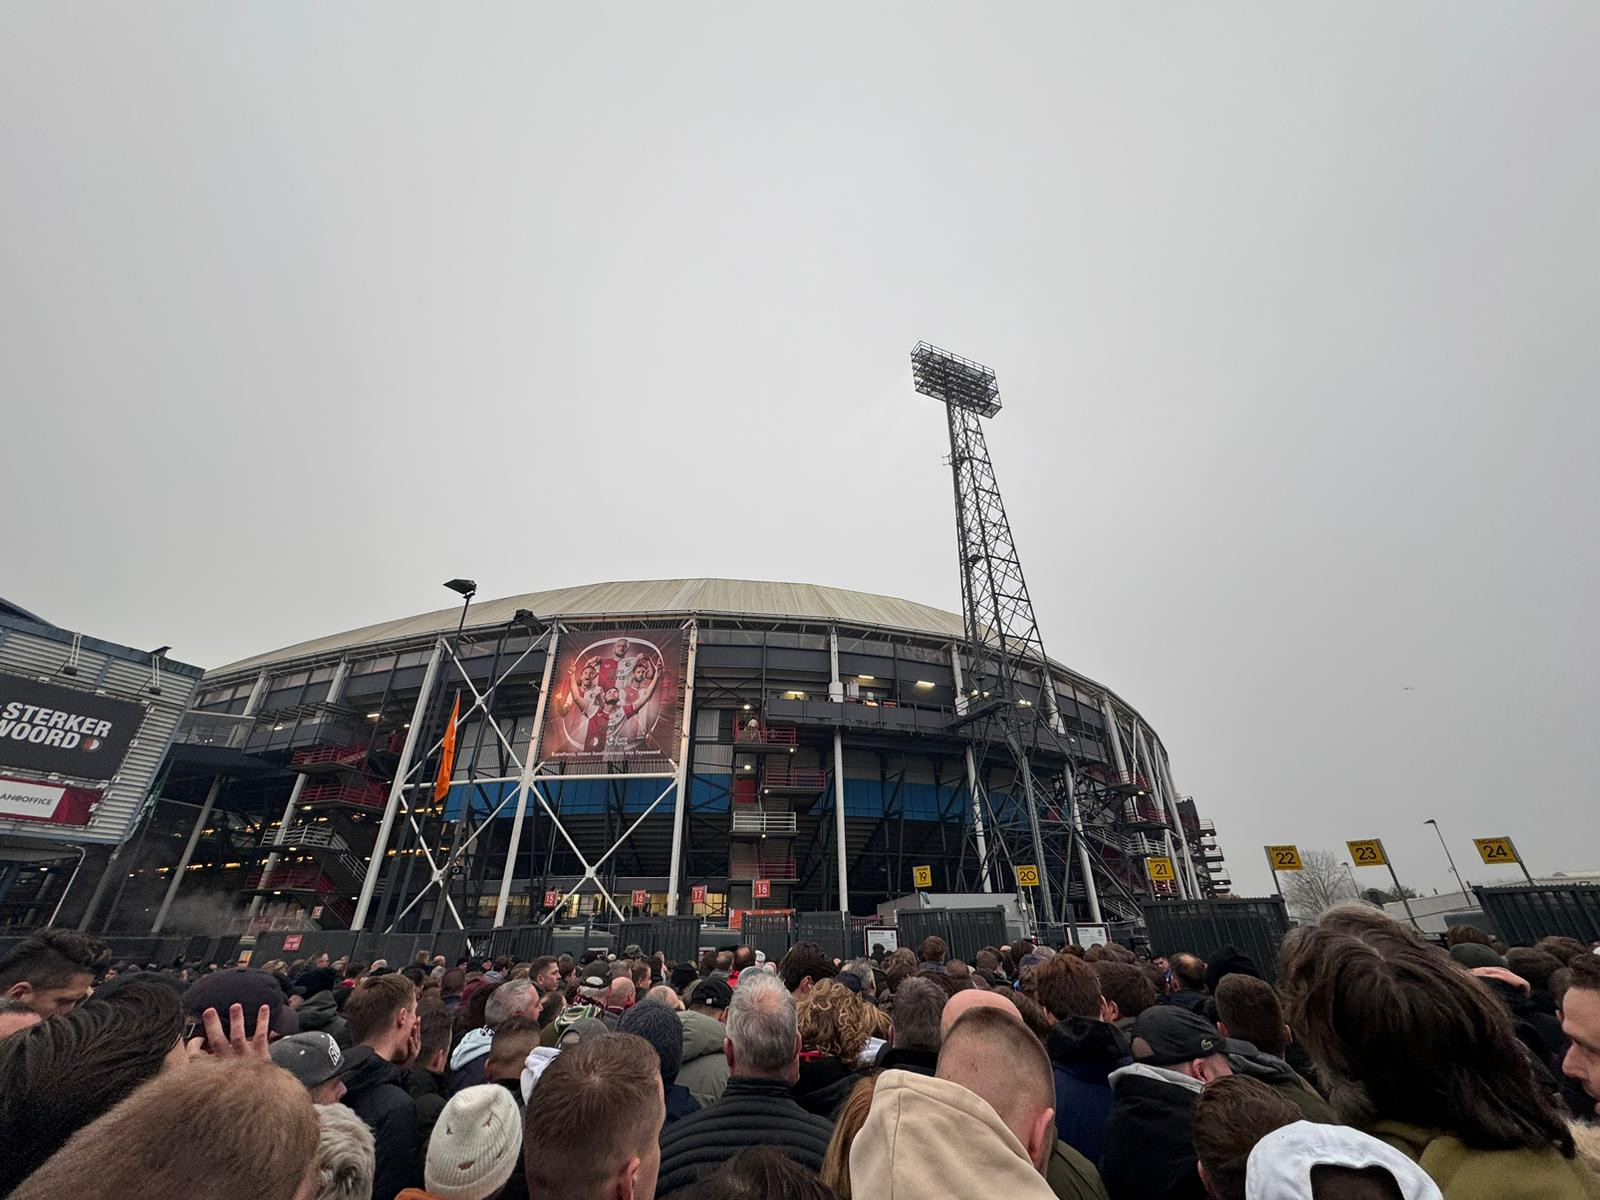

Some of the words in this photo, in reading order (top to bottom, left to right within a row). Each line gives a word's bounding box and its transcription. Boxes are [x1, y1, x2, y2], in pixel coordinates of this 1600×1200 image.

[2, 702, 112, 737] STERKER
[1355, 846, 1377, 860] 23
[1483, 844, 1507, 858] 24
[1275, 851, 1297, 865] 22
[1154, 863, 1168, 875] 21
[919, 871, 927, 881] 19
[1019, 870, 1036, 881] 20
[694, 890, 703, 899] 17
[757, 884, 768, 894] 18
[545, 894, 554, 904] 15
[635, 894, 644, 903] 16
